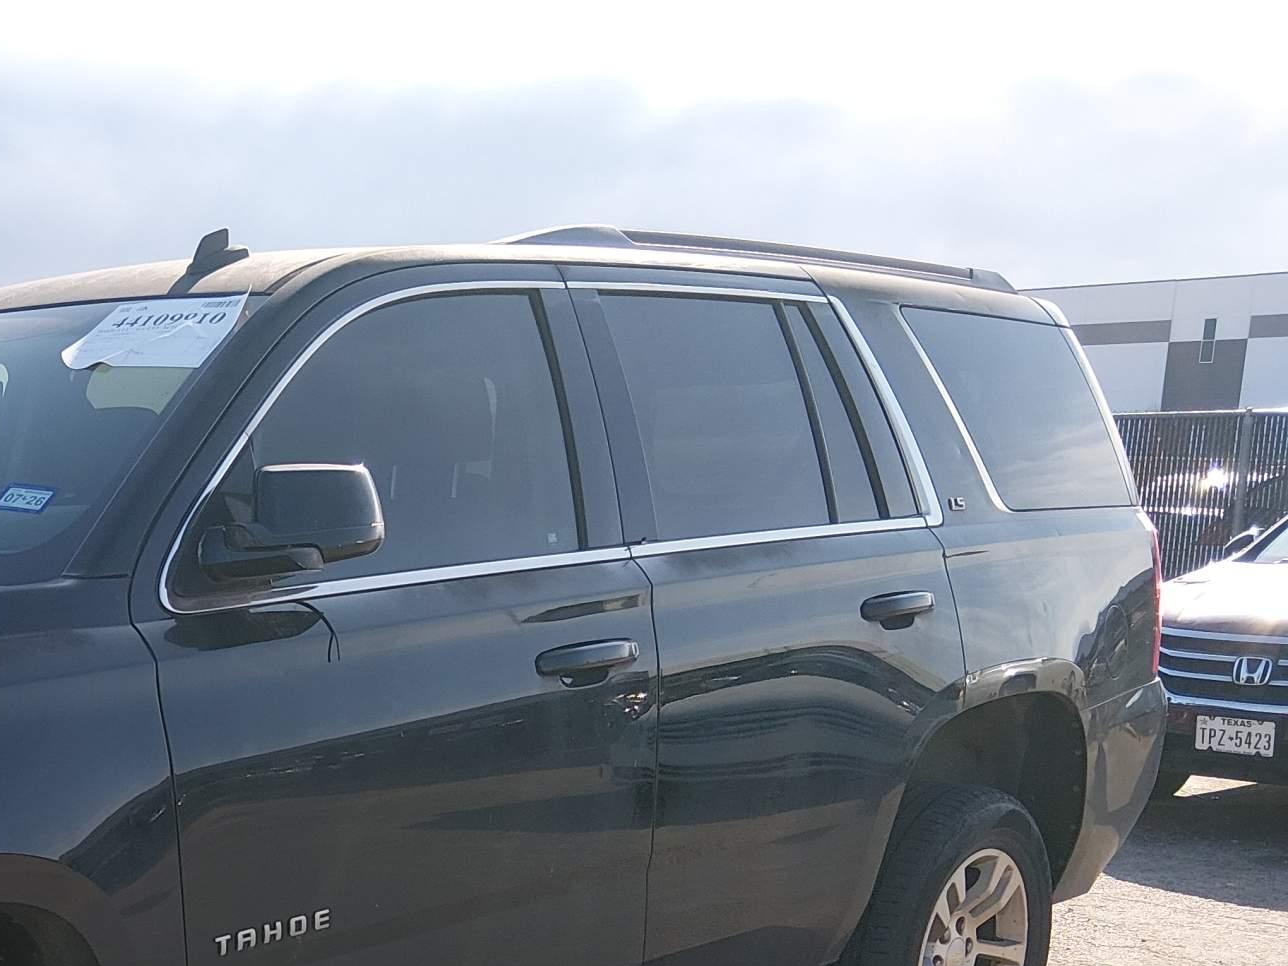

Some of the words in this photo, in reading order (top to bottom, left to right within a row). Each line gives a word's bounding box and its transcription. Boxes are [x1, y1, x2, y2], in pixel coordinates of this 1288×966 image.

[948, 497, 966, 511] LS
[1221, 718, 1252, 728] TEXAS
[214, 908, 330, 956] TAHOE
